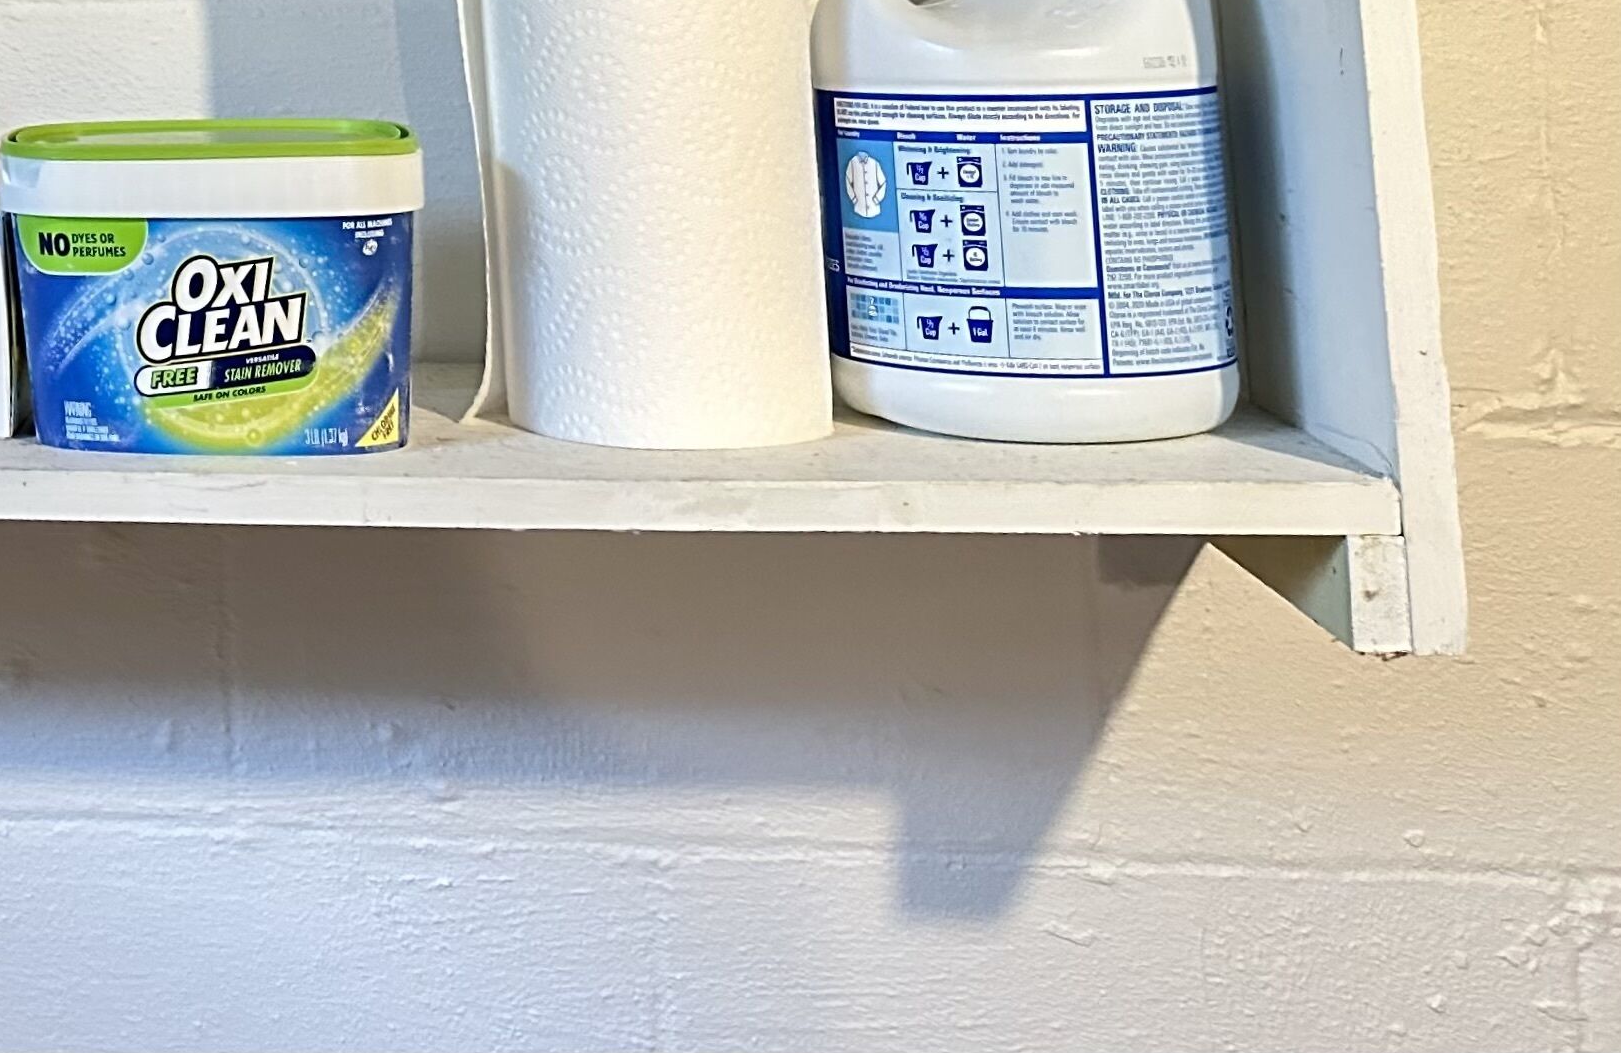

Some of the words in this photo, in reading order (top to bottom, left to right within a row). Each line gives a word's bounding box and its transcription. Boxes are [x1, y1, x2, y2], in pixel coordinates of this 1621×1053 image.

[1094, 103, 1131, 114] STORAGE
[38, 232, 70, 256] NO
[71, 233, 98, 243] DYES
[99, 233, 115, 243] OR
[72, 246, 126, 257] PERFUMES
[173, 256, 272, 313] OXI
[138, 295, 304, 363] CLEAN
[245, 353, 280, 364] VERSATILE
[150, 366, 199, 390] FREE
[224, 367, 252, 383] STAIN
[254, 358, 302, 379] REMOVER
[216, 391, 230, 399] ON
[232, 386, 266, 397] COLORS
